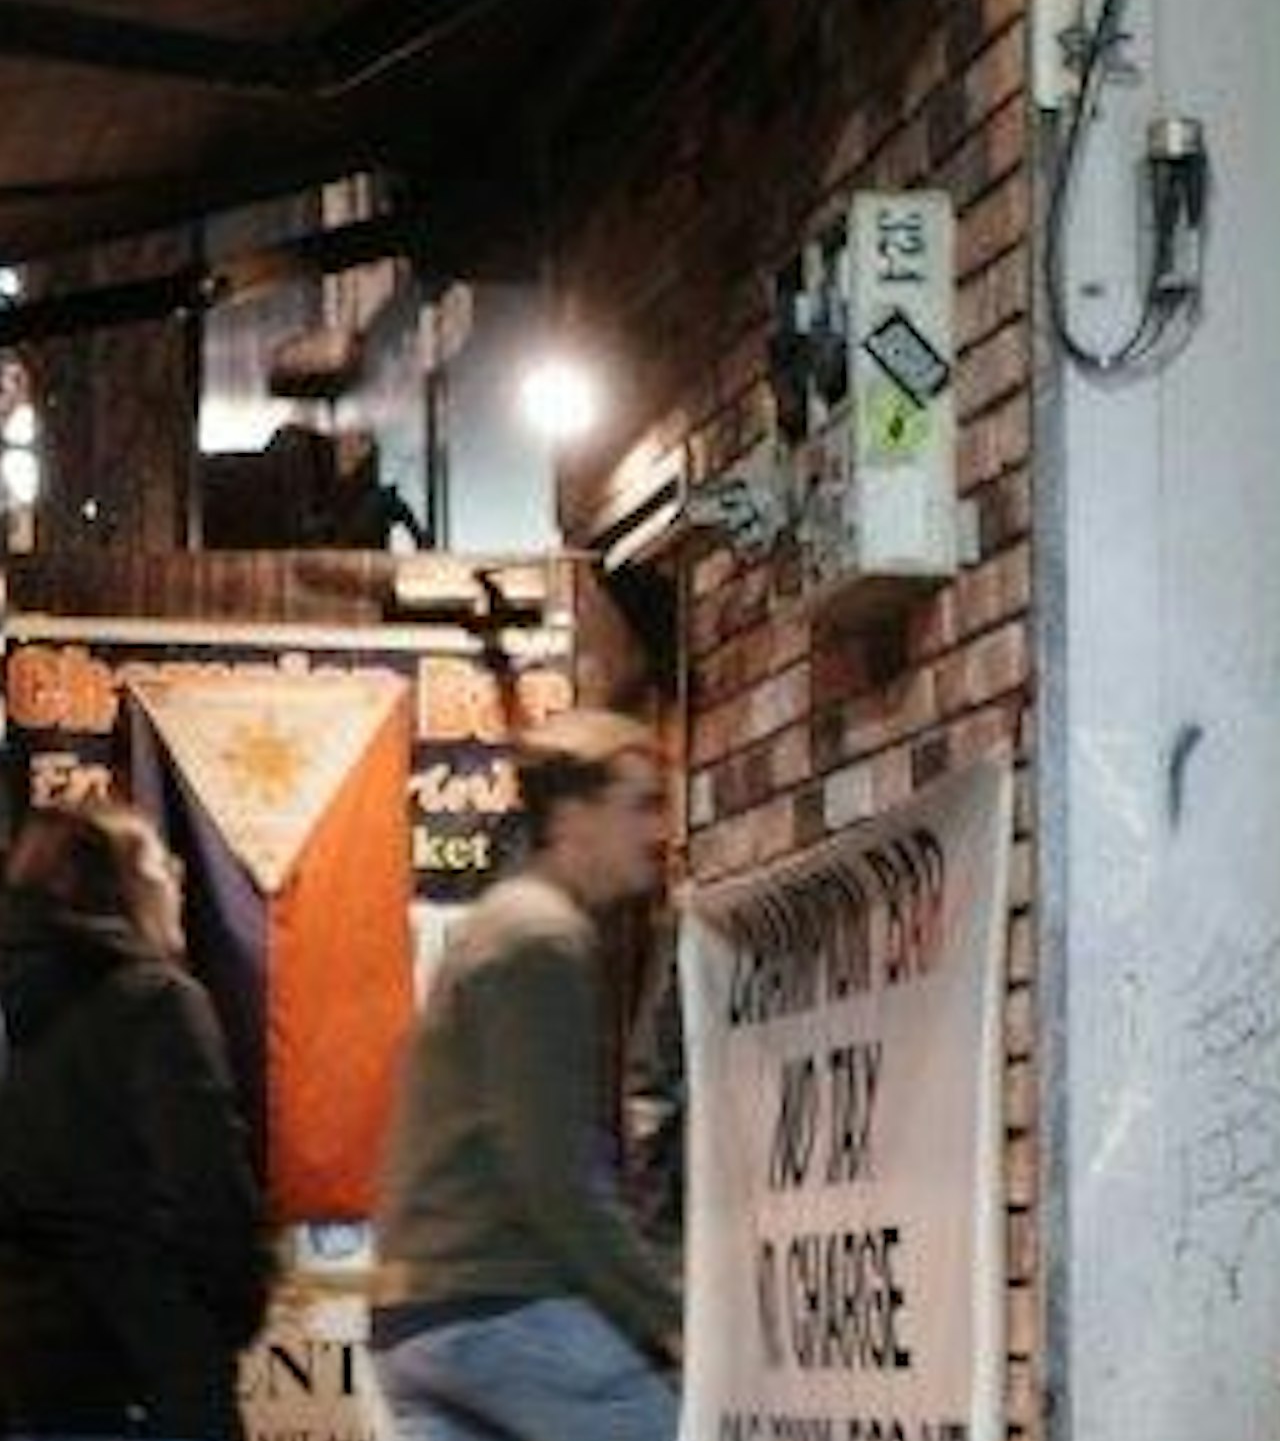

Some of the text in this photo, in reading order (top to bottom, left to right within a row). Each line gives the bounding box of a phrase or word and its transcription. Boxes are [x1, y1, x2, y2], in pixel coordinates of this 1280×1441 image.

[768, 1040, 882, 1191] NO TAX
[786, 1225, 910, 1369] CHARGE
